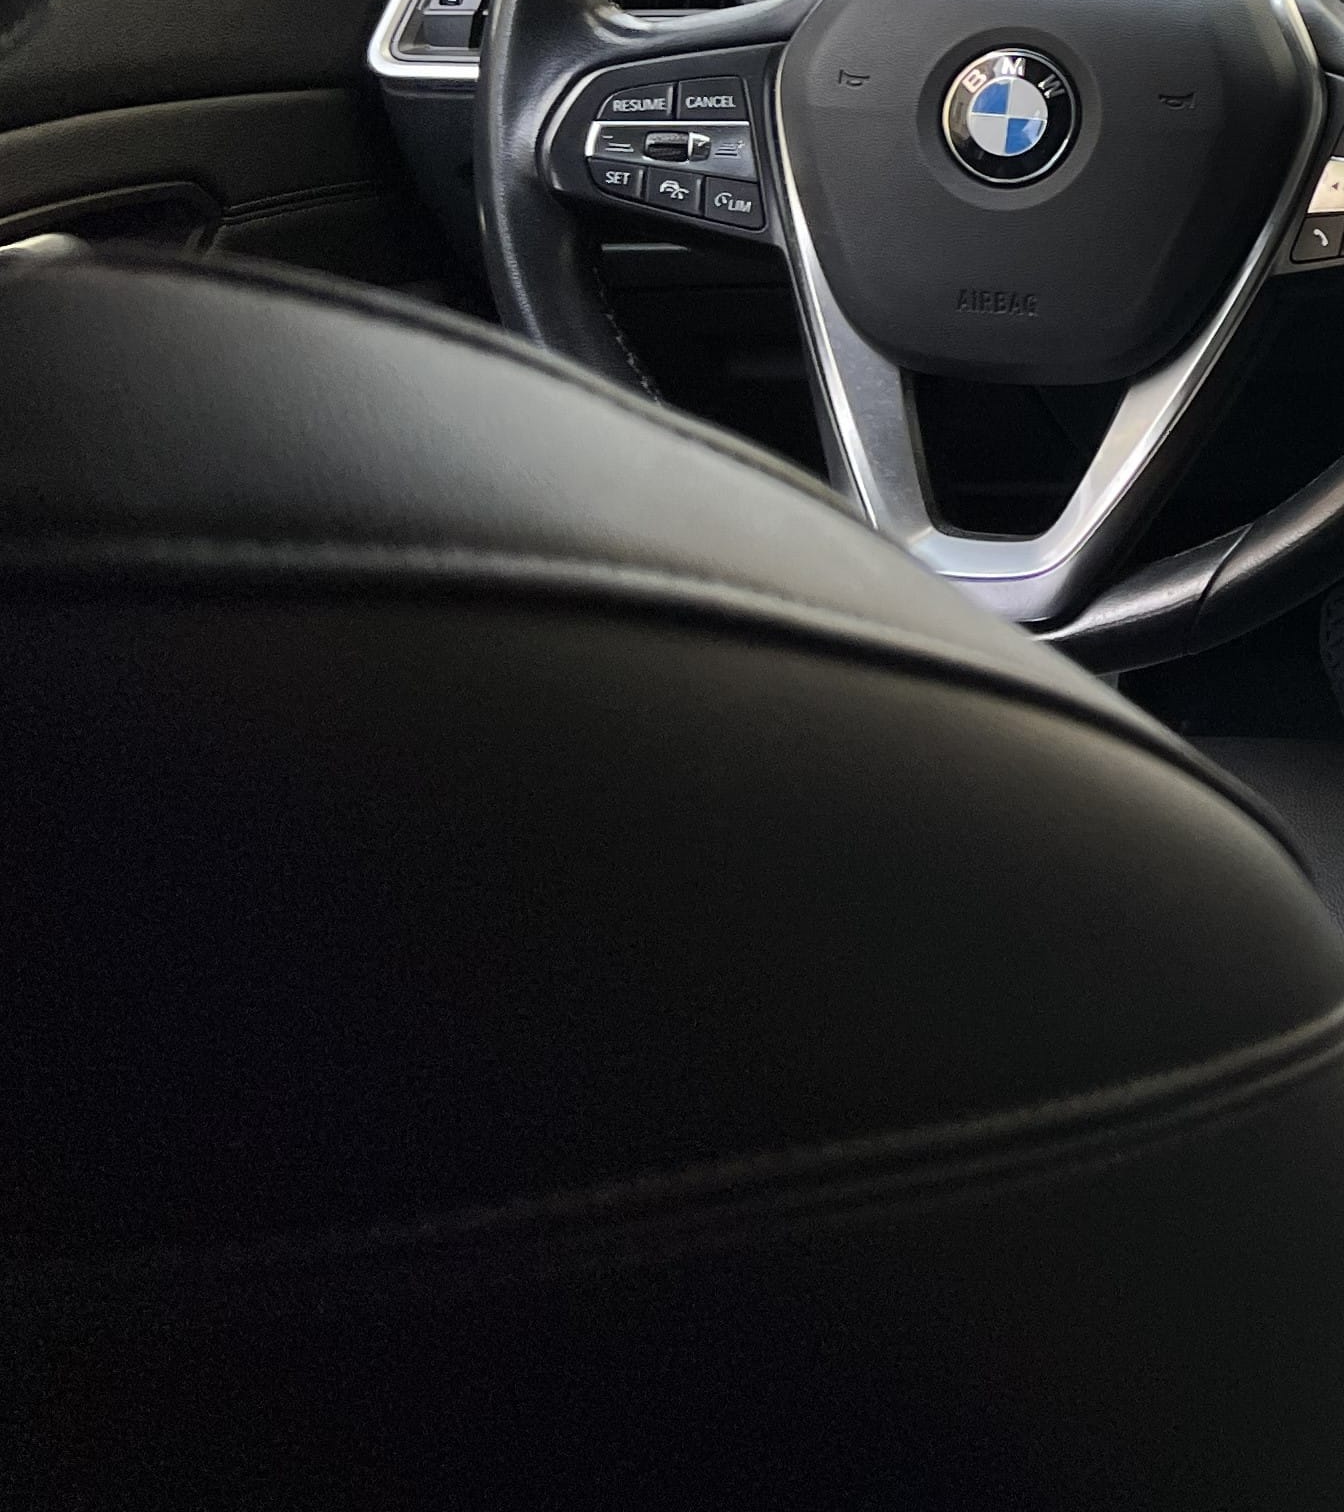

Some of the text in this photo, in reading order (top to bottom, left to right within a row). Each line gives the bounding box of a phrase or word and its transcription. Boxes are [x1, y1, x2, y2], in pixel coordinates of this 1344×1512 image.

[962, 56, 1065, 99] BMW
[613, 98, 667, 112] RESUME
[685, 95, 736, 109] CANCEL
[605, 171, 631, 185] SET
[727, 199, 752, 213] LIM
[955, 289, 1039, 316] AIRBAG
